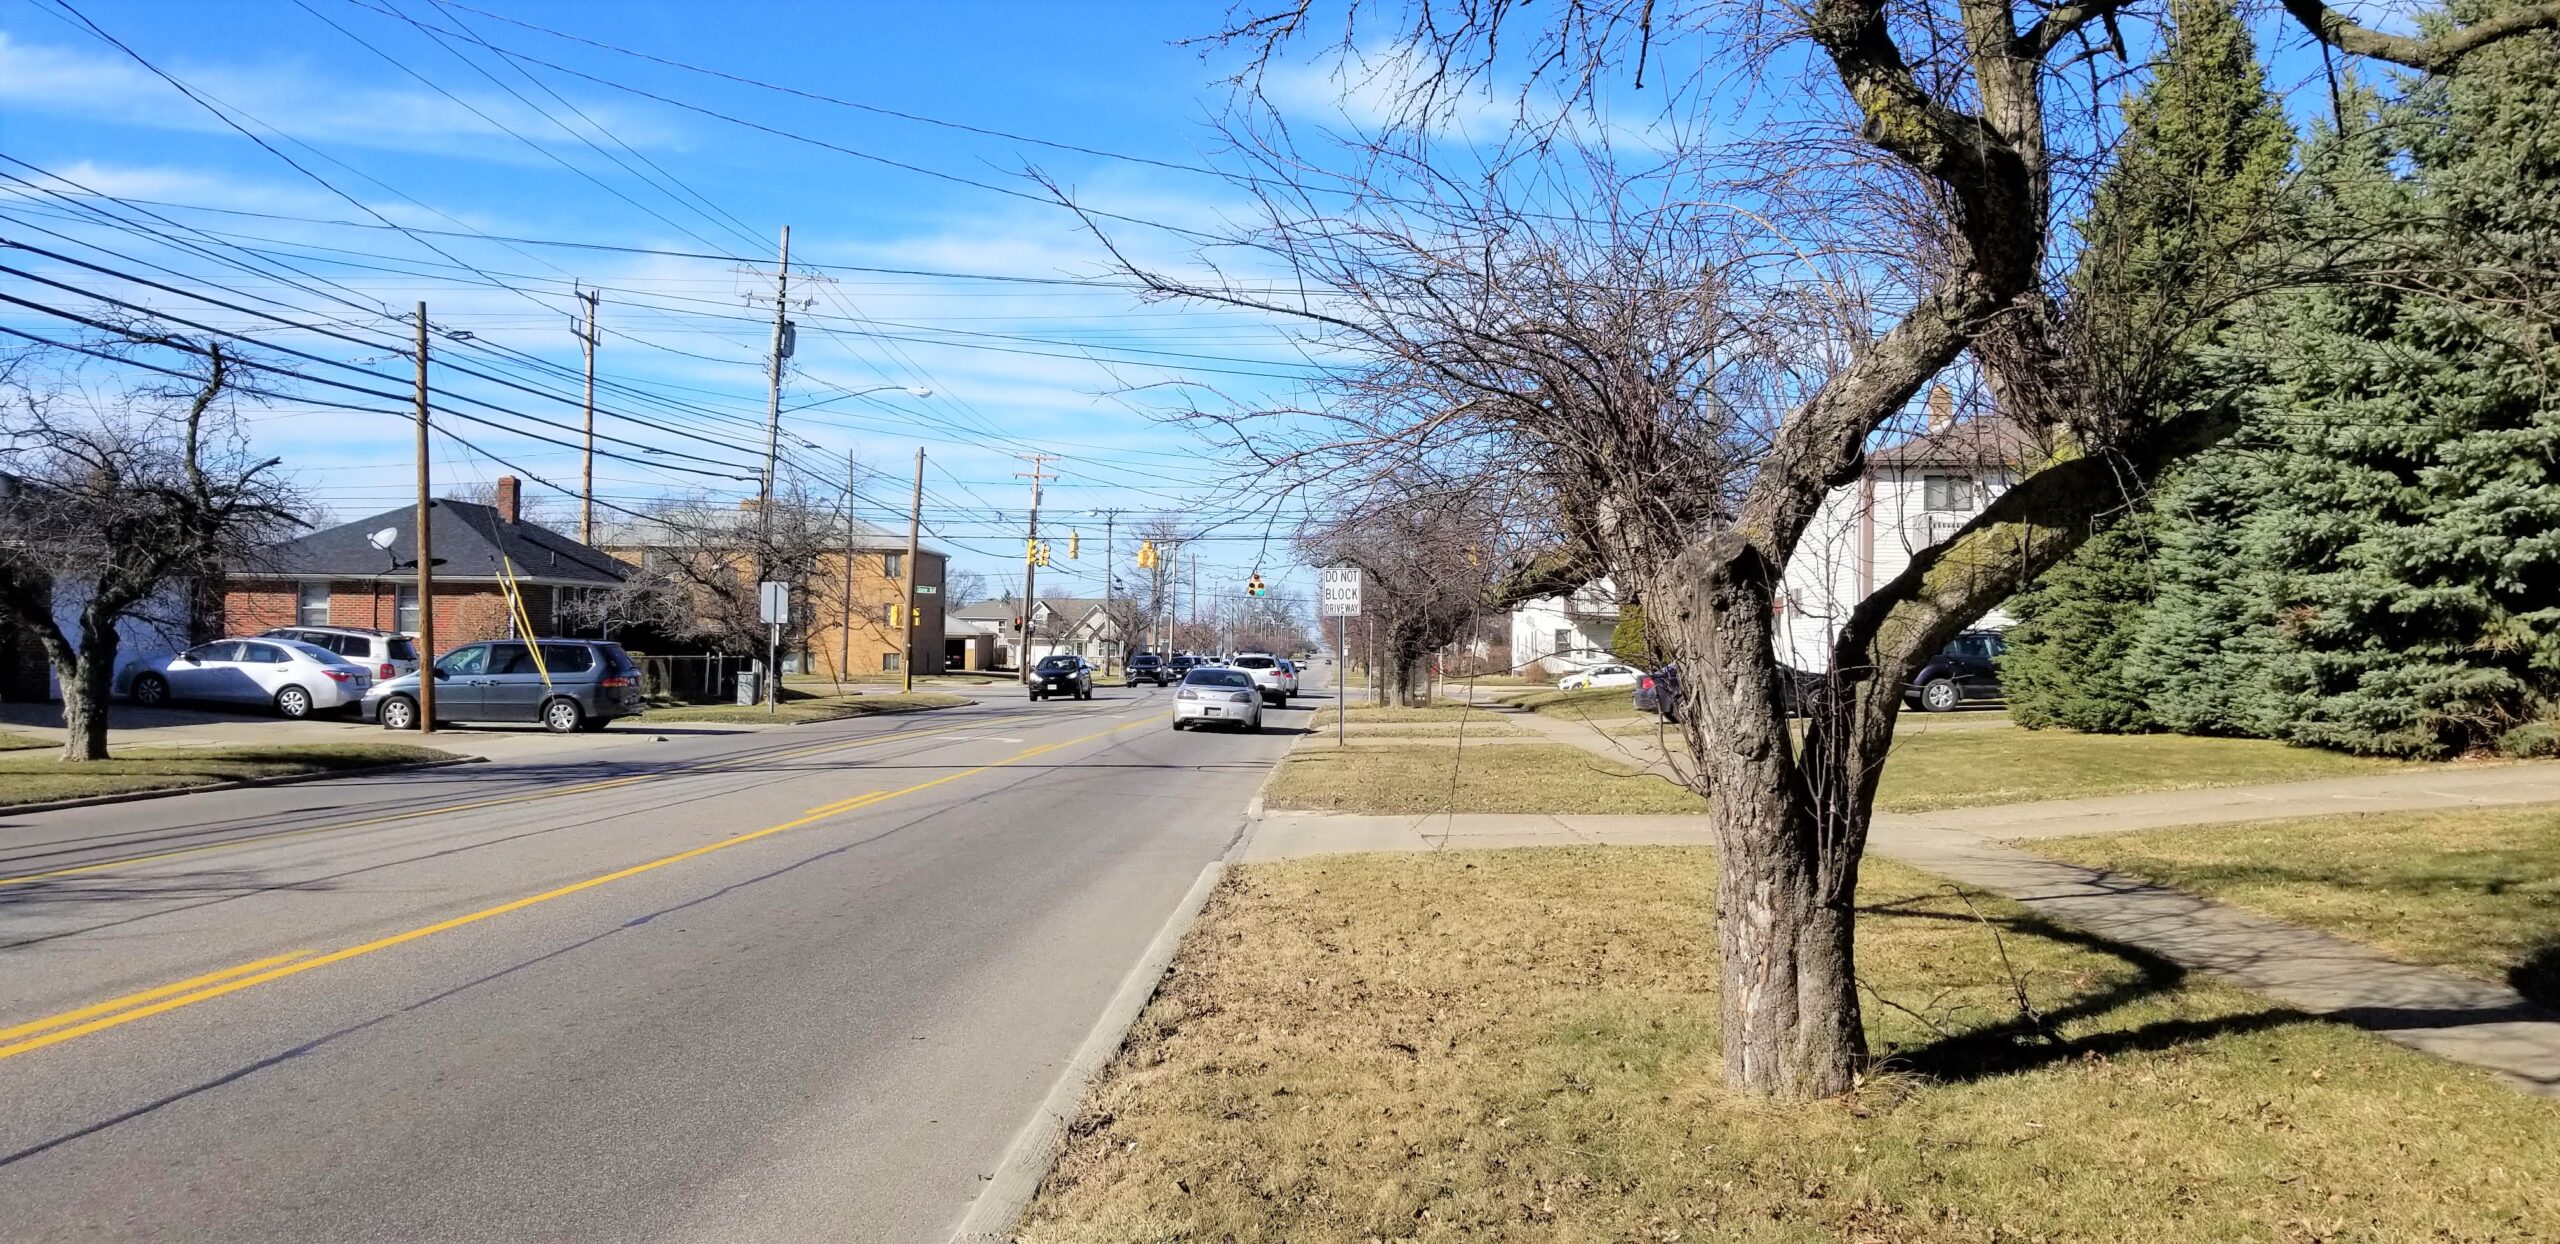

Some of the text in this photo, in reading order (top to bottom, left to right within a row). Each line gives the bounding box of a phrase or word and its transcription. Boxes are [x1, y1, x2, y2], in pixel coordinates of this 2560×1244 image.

[1325, 570, 1358, 582] DO NOT
[1325, 588, 1358, 600] BLOCK
[1325, 603, 1359, 614] DRIVEWAY
